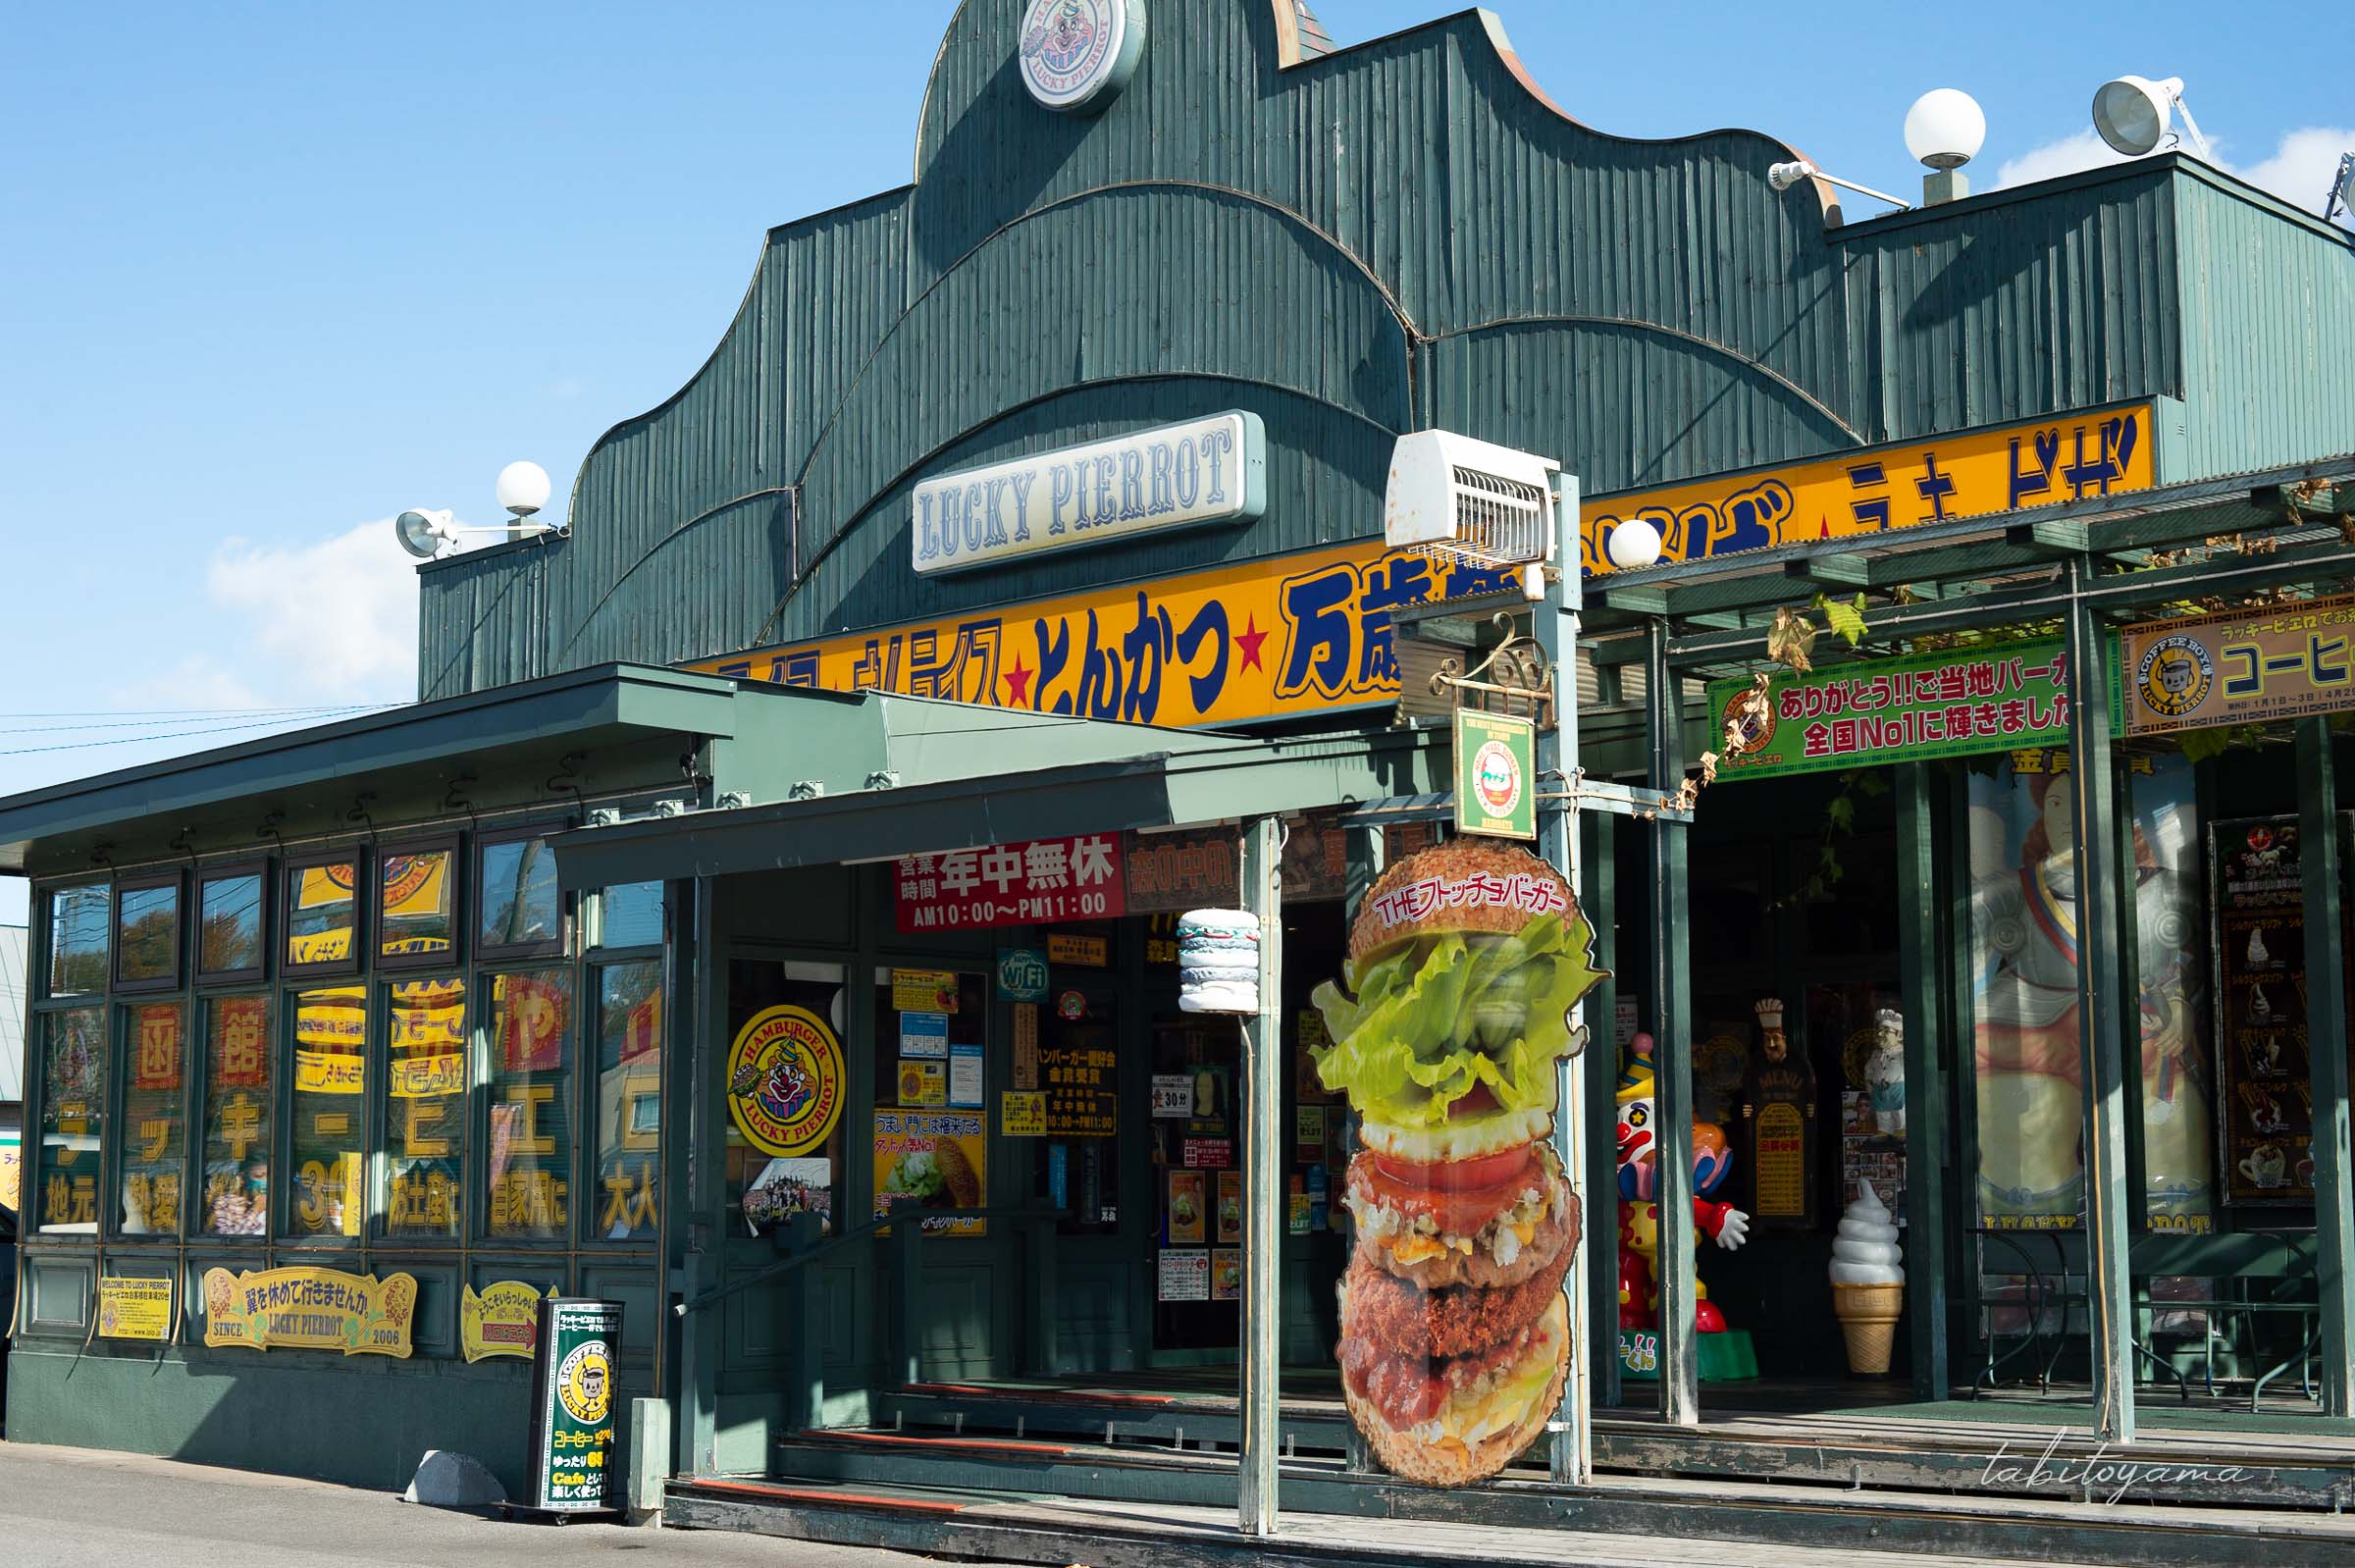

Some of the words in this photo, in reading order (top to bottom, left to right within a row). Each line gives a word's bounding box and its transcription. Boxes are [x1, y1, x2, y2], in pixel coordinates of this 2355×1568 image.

[1032, 62, 1068, 89] LUCKY
[1071, 20, 1108, 84] PIERROT
[918, 467, 1036, 560] LUCKY
[1049, 428, 1232, 536] PIERROT
[1034, 591, 1230, 724] とんかつ
[2140, 636, 2188, 678] COFFEE
[2187, 639, 2212, 667] BOY
[2140, 683, 2172, 714] LUCKY
[2172, 675, 2211, 716] PIERROT
[898, 856, 935, 877] 営業
[940, 835, 1115, 900] 年中無休
[1129, 842, 1232, 894] 森の中の
[901, 880, 936, 902] 時間
[1375, 869, 1567, 927] THEフトッチョバーガー
[746, 1019, 827, 1062] HAMBURGER
[747, 1103, 787, 1142] LUCKY
[792, 1075, 833, 1142] PIERROT
[46, 1173, 96, 1224] 地元
[132, 1281, 148, 1289] LUCKY
[149, 1281, 170, 1289] PIERROT
[213, 1322, 242, 1337] SINCE
[268, 1313, 297, 1334] LUCKY
[301, 1314, 343, 1337] PIERROT
[372, 1329, 399, 1345] 2006
[560, 1384, 587, 1421] LUCKY
[553, 1430, 595, 1447] コーヒー
